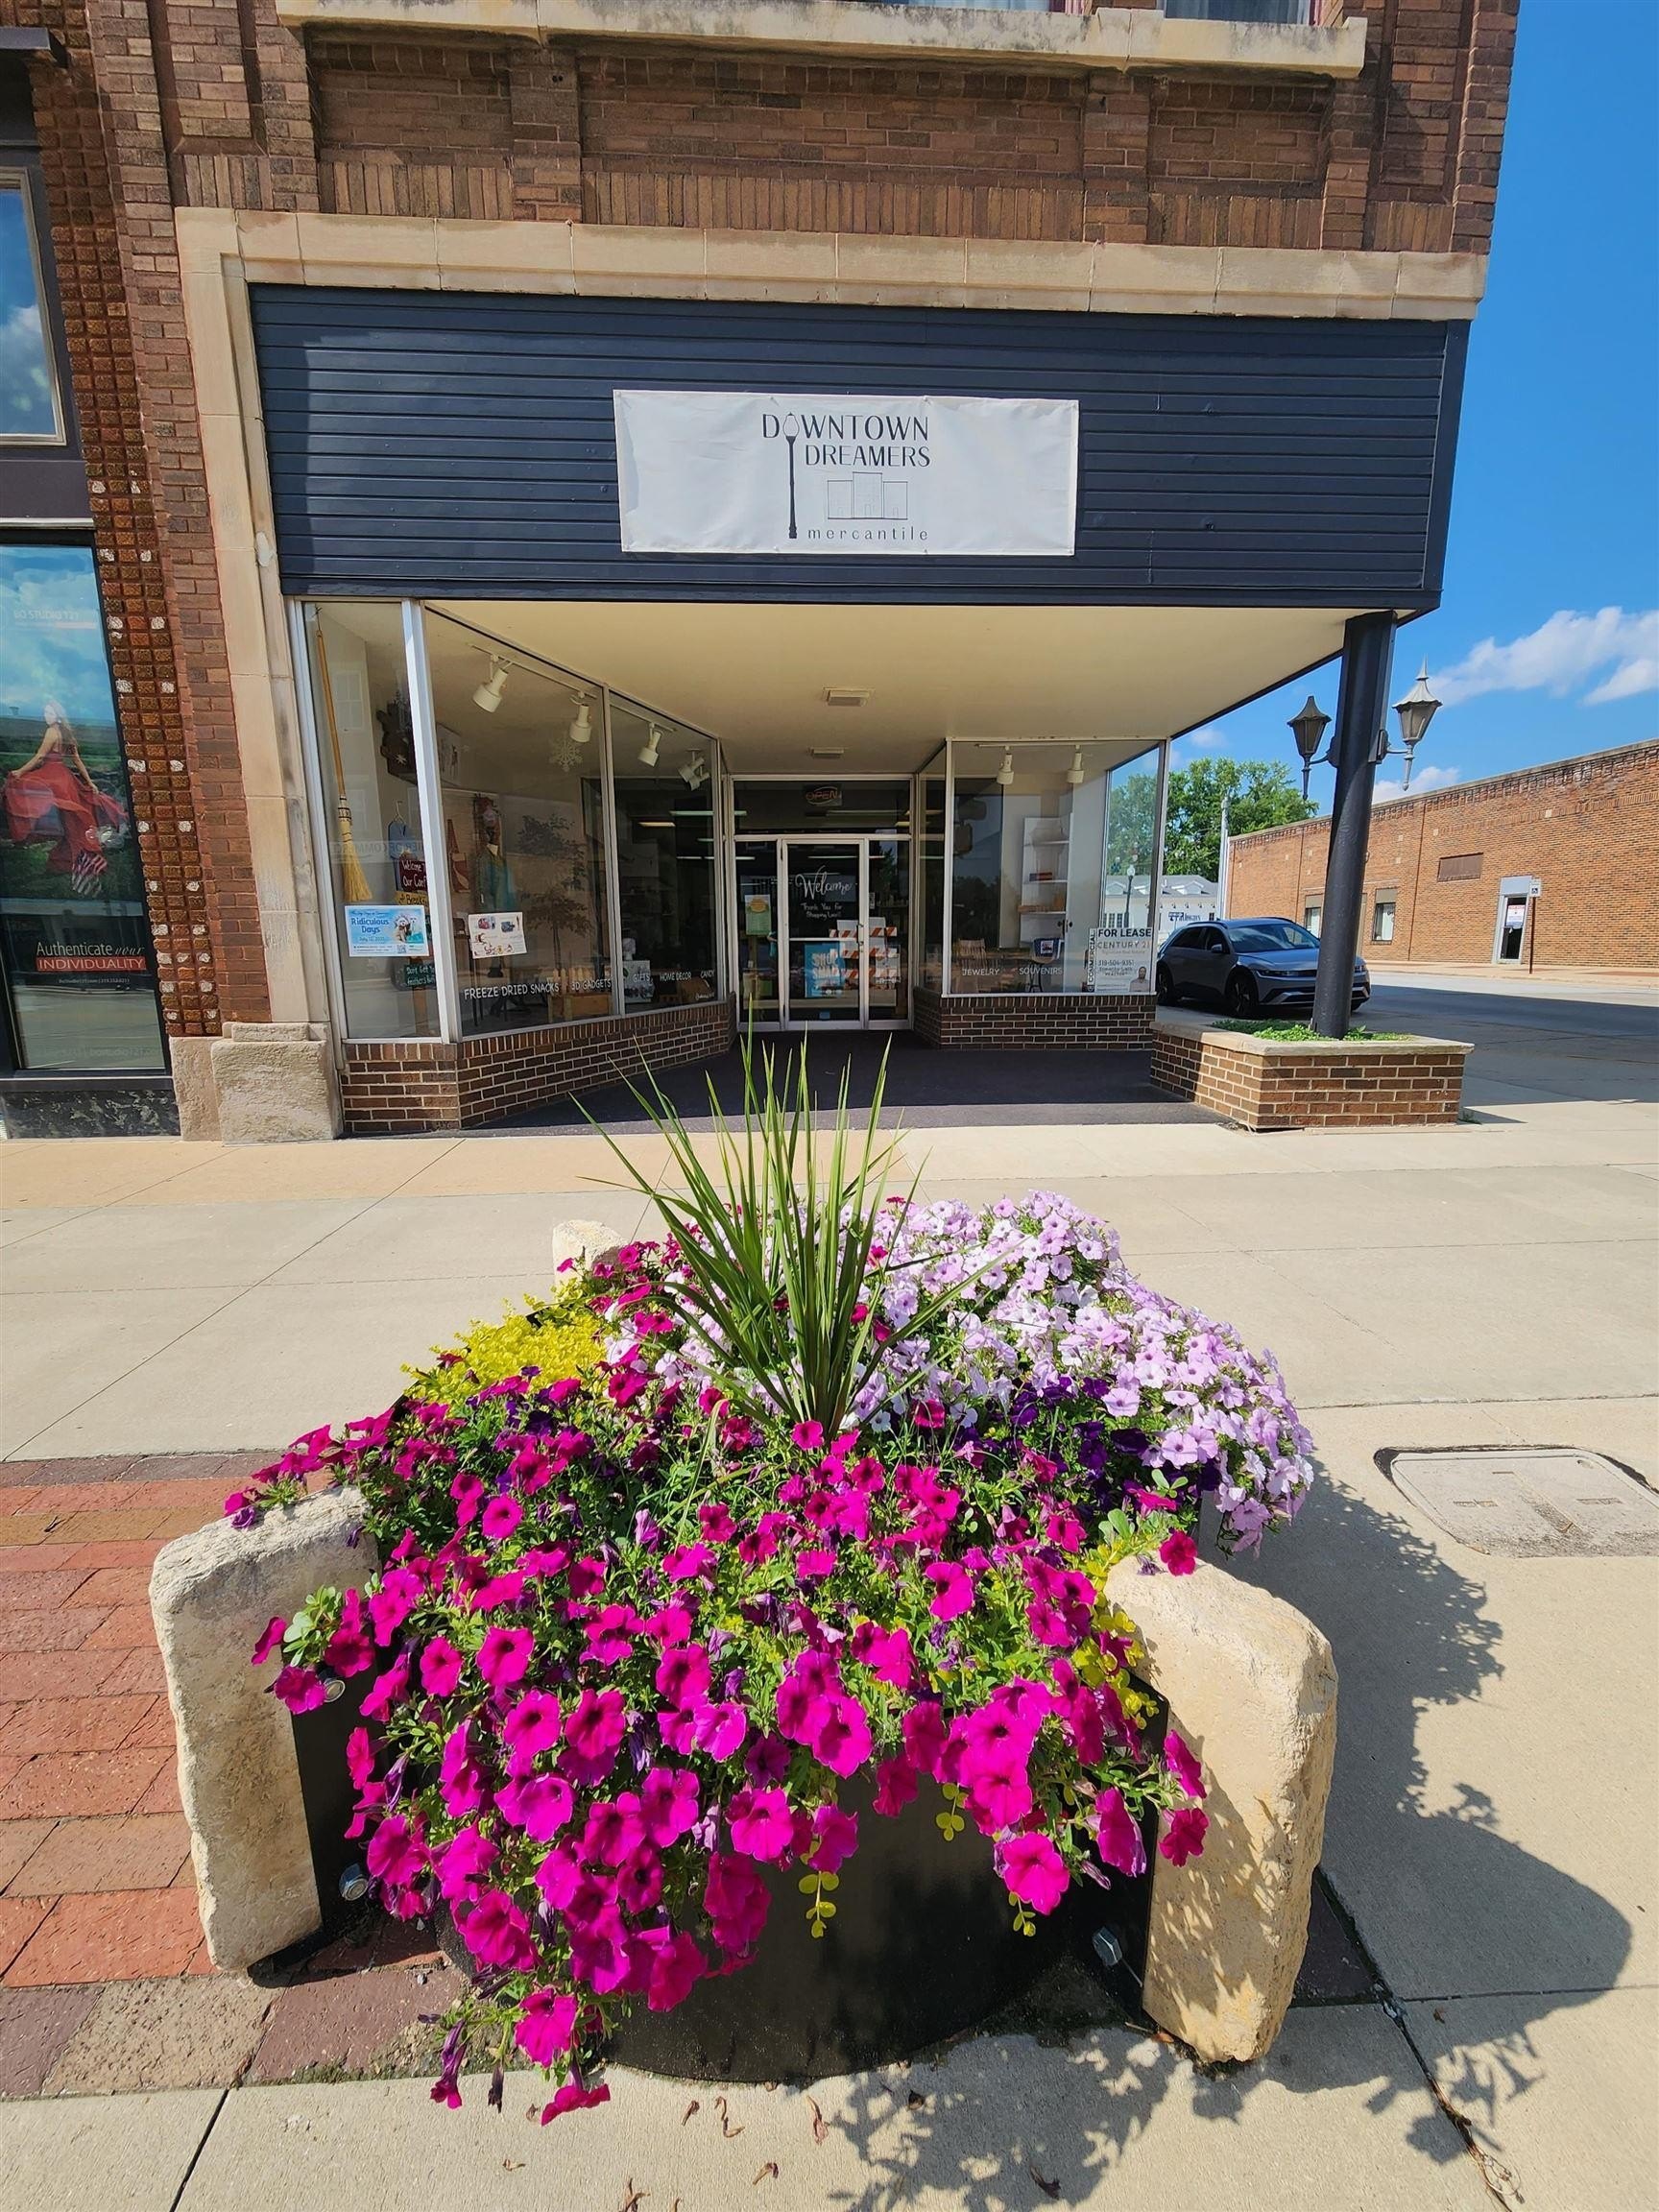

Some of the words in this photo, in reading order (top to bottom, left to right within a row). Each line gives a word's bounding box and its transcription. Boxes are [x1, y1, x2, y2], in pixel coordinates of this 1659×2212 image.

[762, 413, 928, 441] DOWNTOWN
[805, 444, 931, 468] DREAMERS
[807, 526, 928, 541] mercantile
[806, 790, 838, 801] OPEN
[795, 865, 853, 900] Welcome
[351, 917, 389, 926] Ridiculous
[361, 926, 381, 935] Days
[1098, 928, 1118, 937] FOR
[1119, 928, 1152, 937] LEASE
[36, 941, 113, 956] Authenticate
[114, 944, 146, 956] your
[39, 958, 144, 970] INDIVIDUALITY
[633, 973, 651, 982] GIFTS
[660, 972, 675, 981] HOME
[676, 971, 692, 980] DECOR
[700, 969, 715, 978] CANDY
[962, 968, 999, 976] JEWELRY
[1019, 967, 1063, 975] SOUVENIRS
[463, 986, 498, 1000] FREEZE
[501, 983, 528, 997] DRIED
[530, 982, 560, 994] SNACKS
[571, 981, 581, 991] 3D
[583, 978, 612, 990] GADGETS
